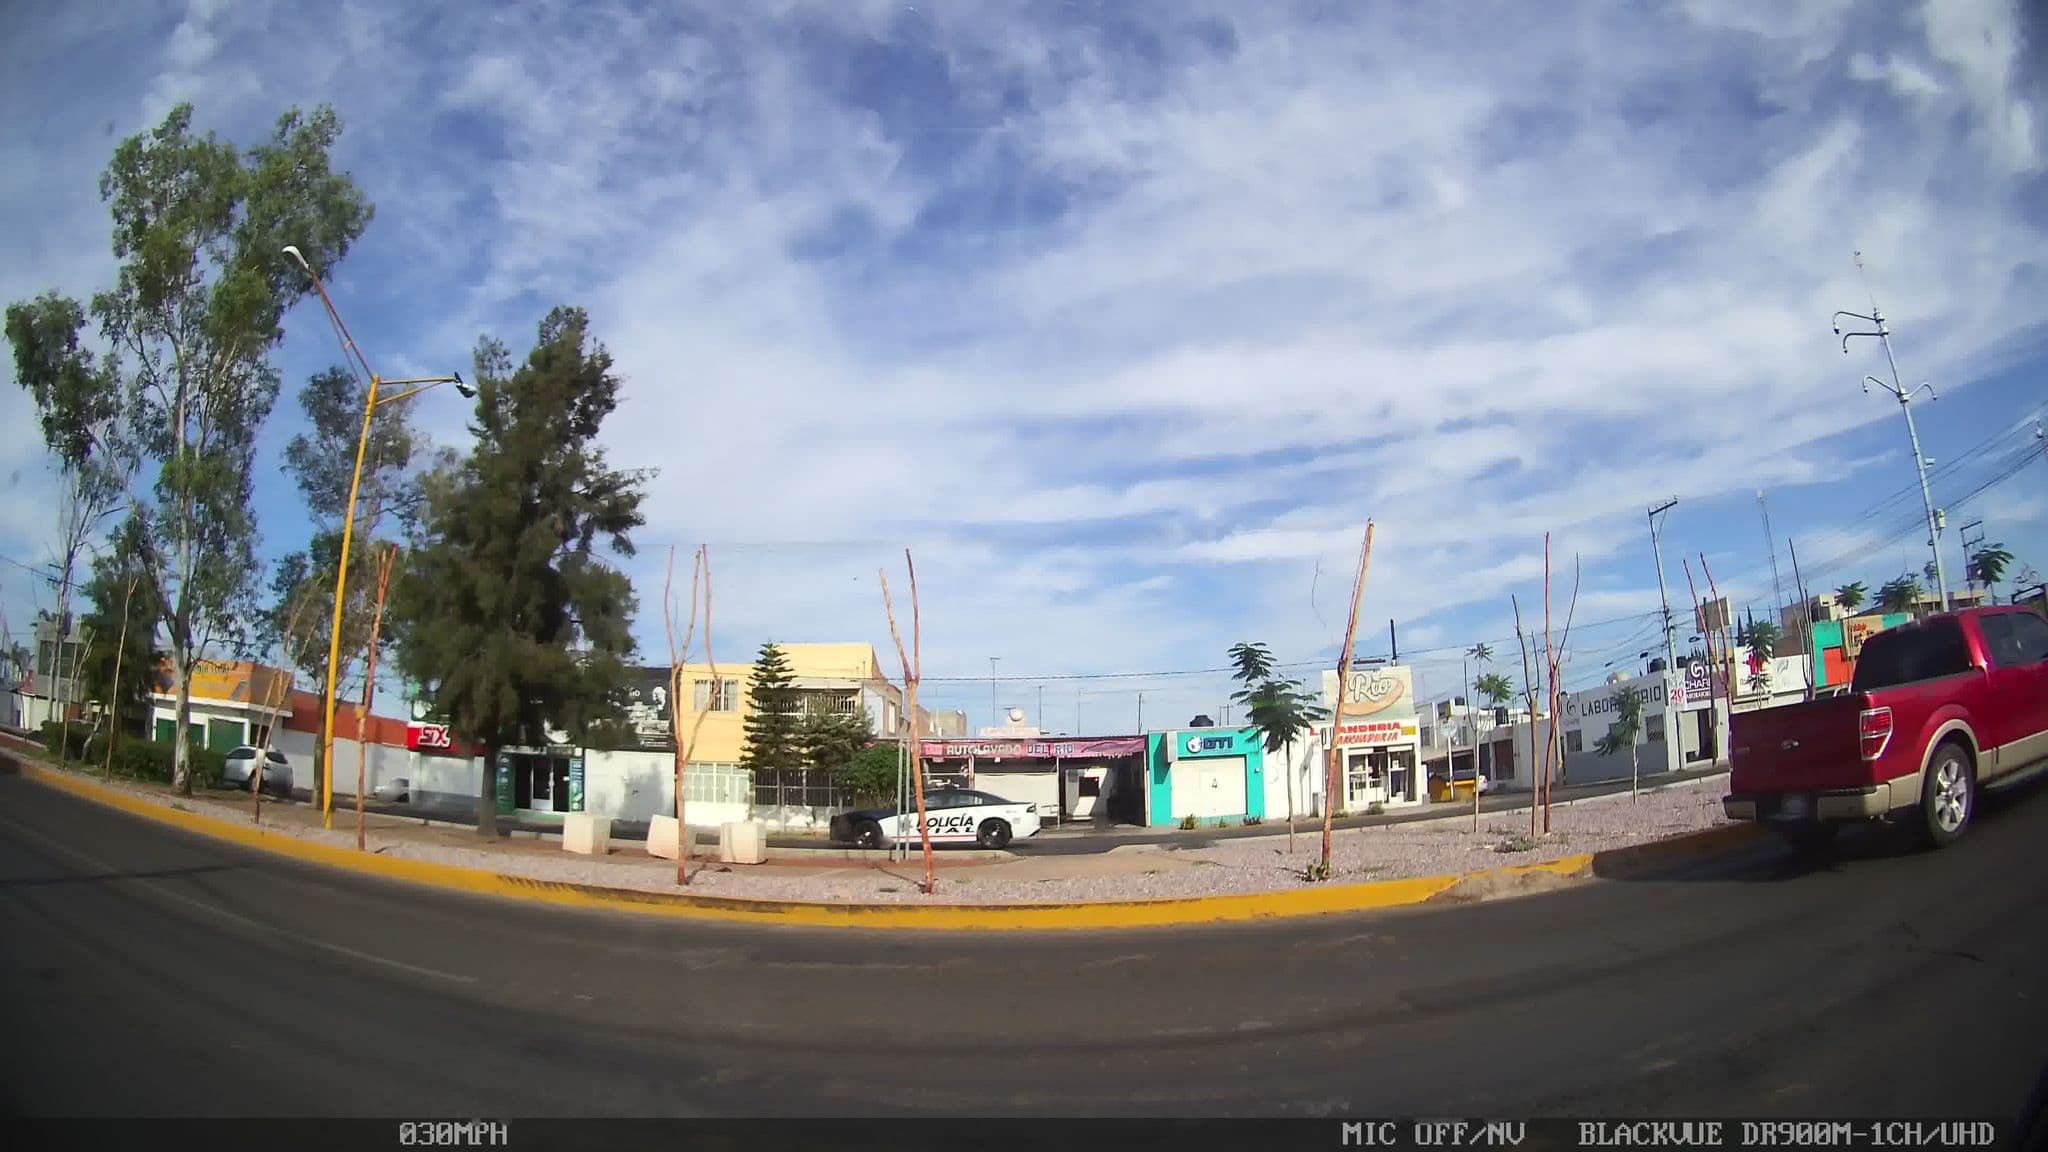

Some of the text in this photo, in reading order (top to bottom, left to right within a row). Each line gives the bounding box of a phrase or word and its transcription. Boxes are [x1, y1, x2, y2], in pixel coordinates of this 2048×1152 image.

[1347, 670, 1391, 703] Rio
[946, 743, 1021, 756] AUTOLAVADO
[1027, 744, 1049, 755] DEL
